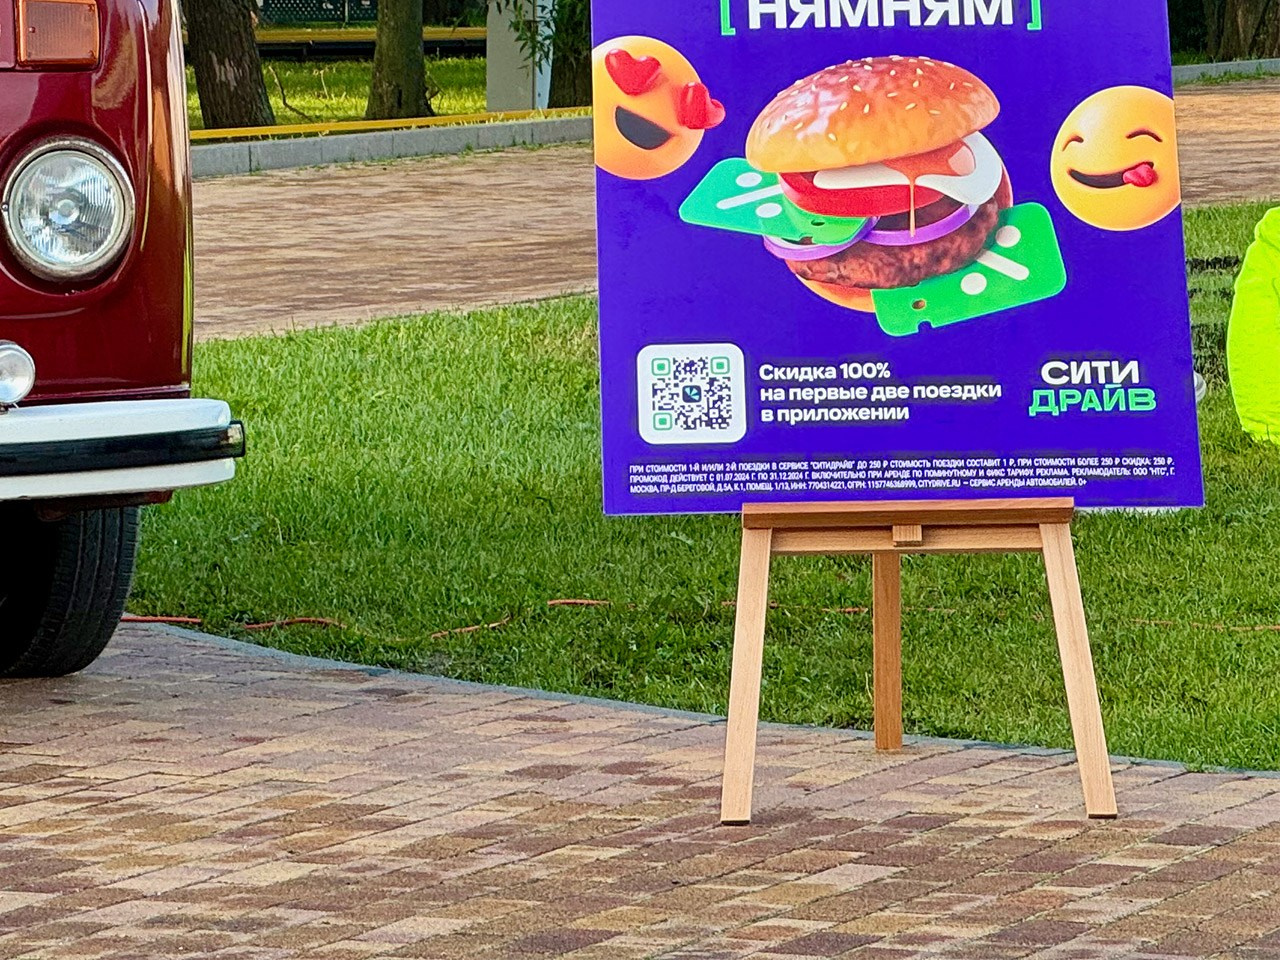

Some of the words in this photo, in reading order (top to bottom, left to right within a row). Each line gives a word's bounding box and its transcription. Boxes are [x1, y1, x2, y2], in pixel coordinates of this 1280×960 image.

[759, 364, 837, 382] Скидка
[839, 362, 891, 379] 100%
[1041, 360, 1140, 385] СИТИ
[760, 387, 785, 401] на
[789, 386, 868, 404] первые
[871, 386, 909, 402] две
[913, 384, 1002, 400] поездки
[1028, 383, 1157, 416] ДРАЙВ
[761, 409, 774, 422] в
[777, 406, 909, 425] приложении
[629, 465, 644, 474] ПРИ
[645, 464, 687, 473] СТОИМОСТИ
[689, 463, 700, 472] 1-Й
[701, 463, 724, 472] И/ИЛИ
[725, 461, 737, 471] 2-Й
[738, 462, 770, 472] ПОЕЗДКИ
[771, 462, 777, 470] В
[778, 461, 809, 470] СЕРВИСЕ
[857, 461, 867, 470] ДО
[868, 460, 881, 469] 250
[889, 459, 931, 468] СТОИМОСТЬ
[932, 459, 965, 468] ПОЕЗДКИ
[966, 458, 1001, 467] СОСТАВИТ
[1002, 458, 1007, 466] 1
[1017, 458, 1032, 466] ПРИ
[1033, 458, 1076, 467] СТОИМОСТИ
[1077, 458, 1099, 466] БОЛЕЕ
[1100, 457, 1113, 466] 250
[1153, 457, 1166, 465] 250
[629, 474, 668, 483] ПРОМОКОД
[669, 473, 708, 483] ДЕЙСТВУЕТ
[709, 473, 715, 482] С
[716, 473, 750, 481] 01.07.2024
[757, 472, 768, 480] ПО
[769, 472, 804, 480] 31.12.2024
[811, 470, 866, 480] ВКЛЮЧИТЕЛЬНО
[884, 470, 911, 479] АРЕНДЕ
[912, 470, 923, 478] ПО
[924, 469, 977, 477] ПОМИНУТНОМУ
[986, 468, 1006, 477] ФИКС
[1132, 467, 1148, 475] ООО
[969, 478, 996, 487] СЕРВИС
[996, 478, 1025, 488] АРЕНДЫ
[1078, 478, 1087, 486] 0+
